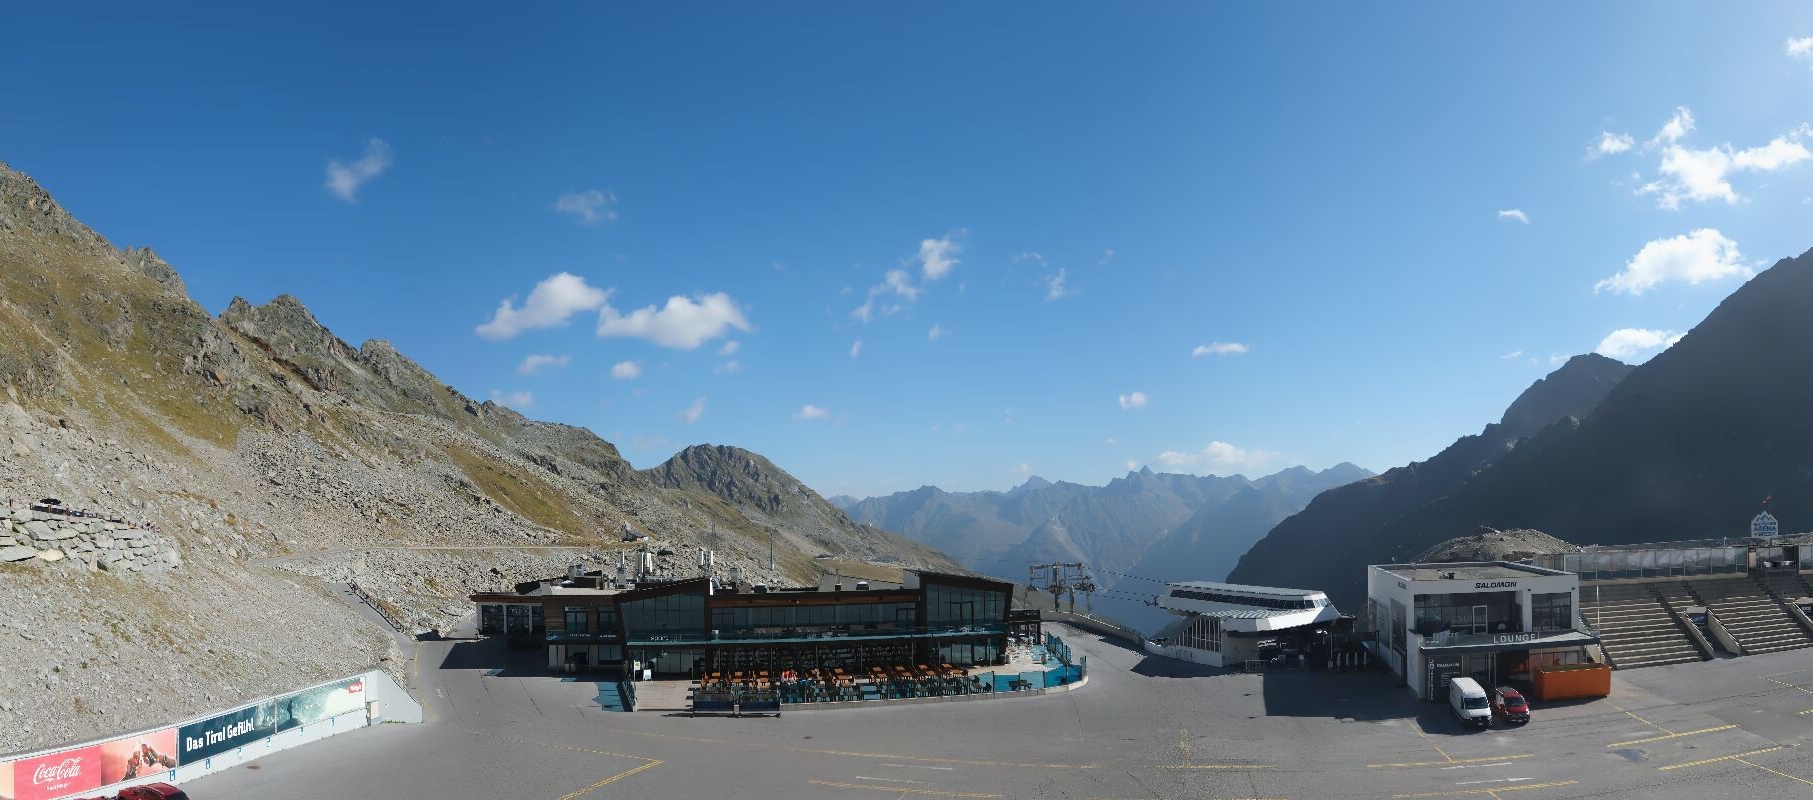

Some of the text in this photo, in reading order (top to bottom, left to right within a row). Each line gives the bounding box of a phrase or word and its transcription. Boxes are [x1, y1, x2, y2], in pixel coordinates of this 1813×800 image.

[1475, 581, 1517, 589] SALOMON
[1493, 633, 1537, 643] LOUNGE
[186, 717, 255, 752] Das Tirol Gefühl
